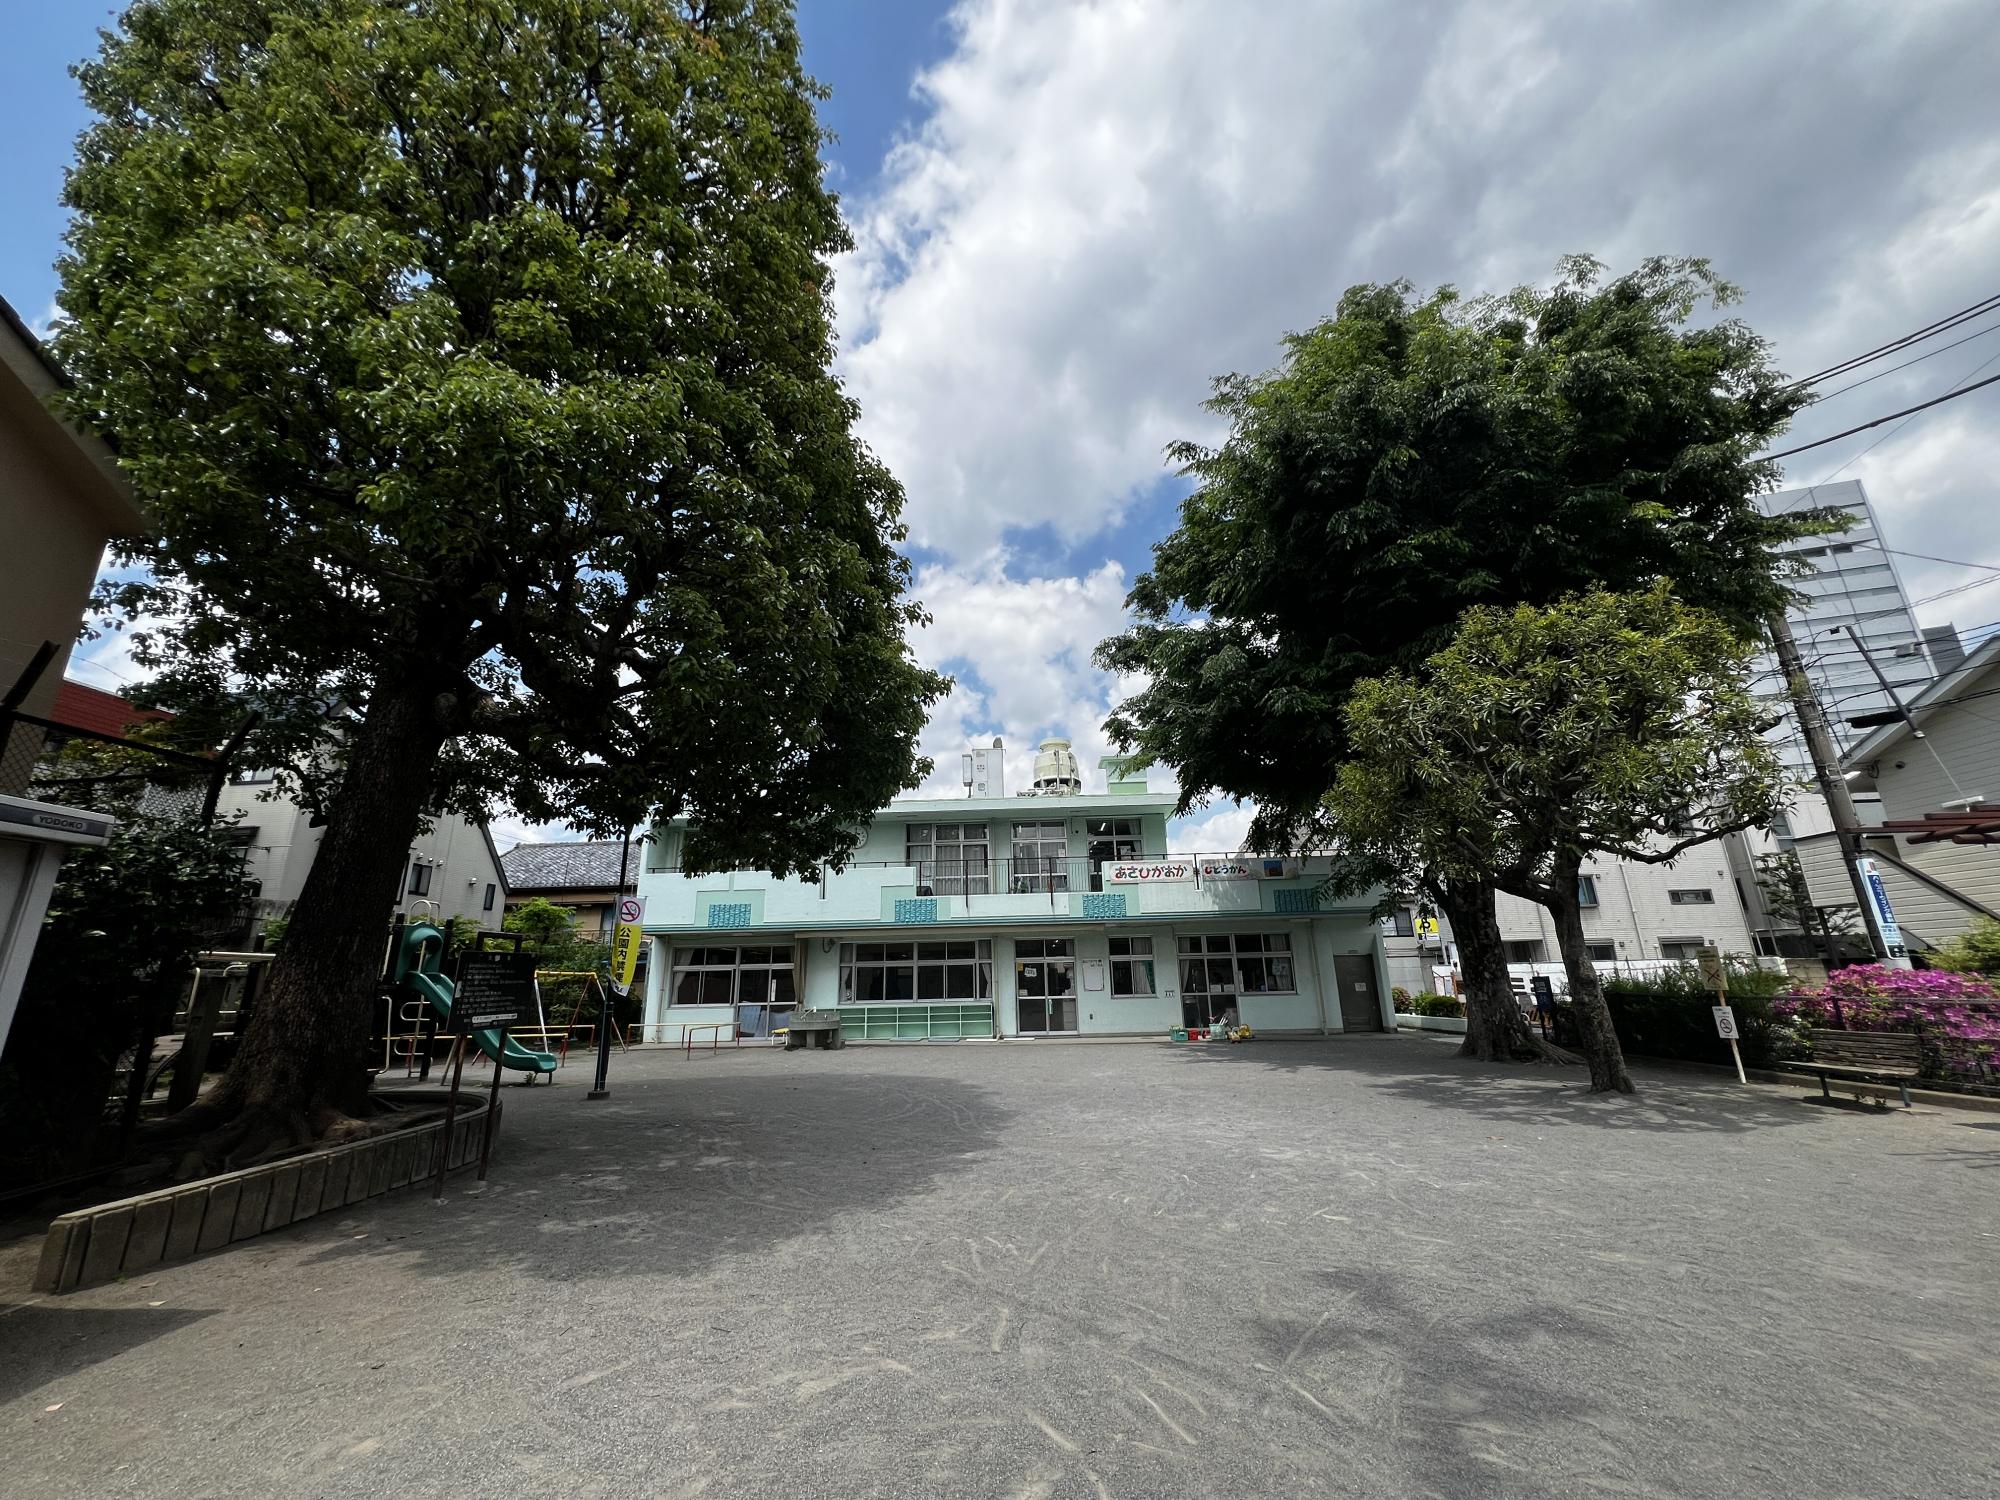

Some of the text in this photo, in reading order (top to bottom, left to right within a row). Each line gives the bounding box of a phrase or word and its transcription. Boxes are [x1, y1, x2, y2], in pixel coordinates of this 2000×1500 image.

[39, 816, 83, 829] YODOKO
[1115, 864, 1247, 879] あさひがおか じどうかん
